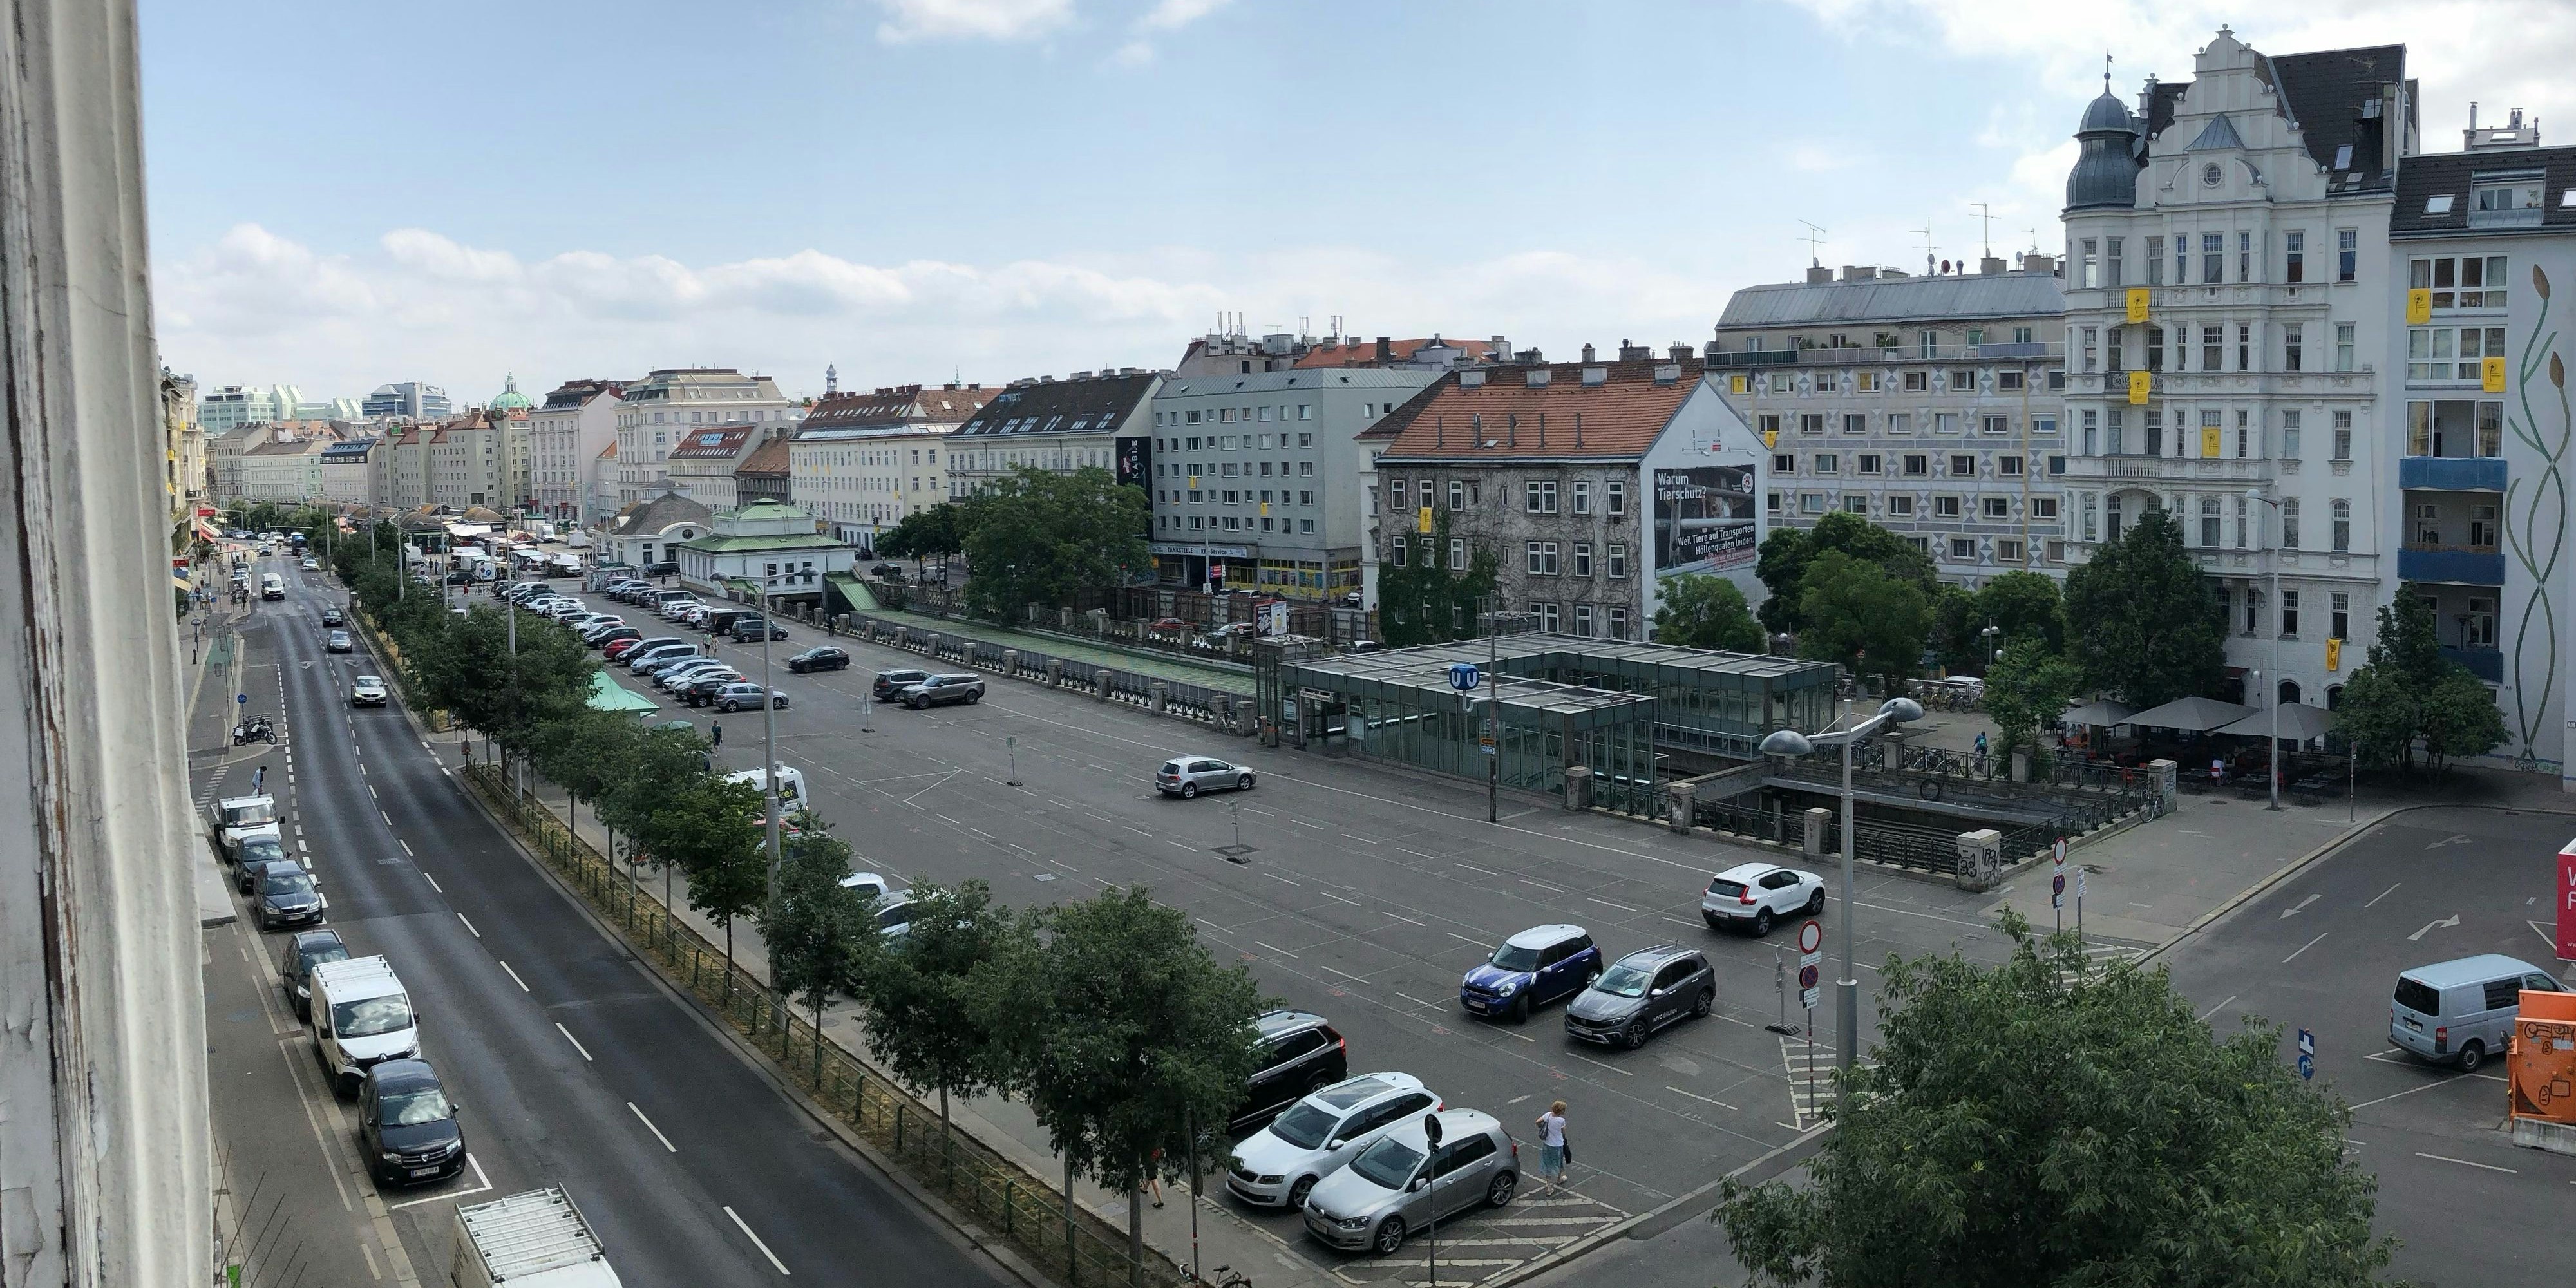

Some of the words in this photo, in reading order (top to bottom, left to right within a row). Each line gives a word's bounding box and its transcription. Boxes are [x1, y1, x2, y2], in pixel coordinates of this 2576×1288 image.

[1658, 473, 1689, 486] Warum
[1658, 486, 1707, 500] Tierschutz?
[1678, 535, 1692, 546] Weil
[1692, 535, 1708, 544] Tiere
[1709, 531, 1718, 540] auf
[1719, 525, 1754, 538] Transporten
[1696, 541, 1734, 555] Höllenqualen
[1736, 536, 1754, 547] leiden.
[1452, 672, 1461, 687] U
[1467, 672, 1477, 687] U
